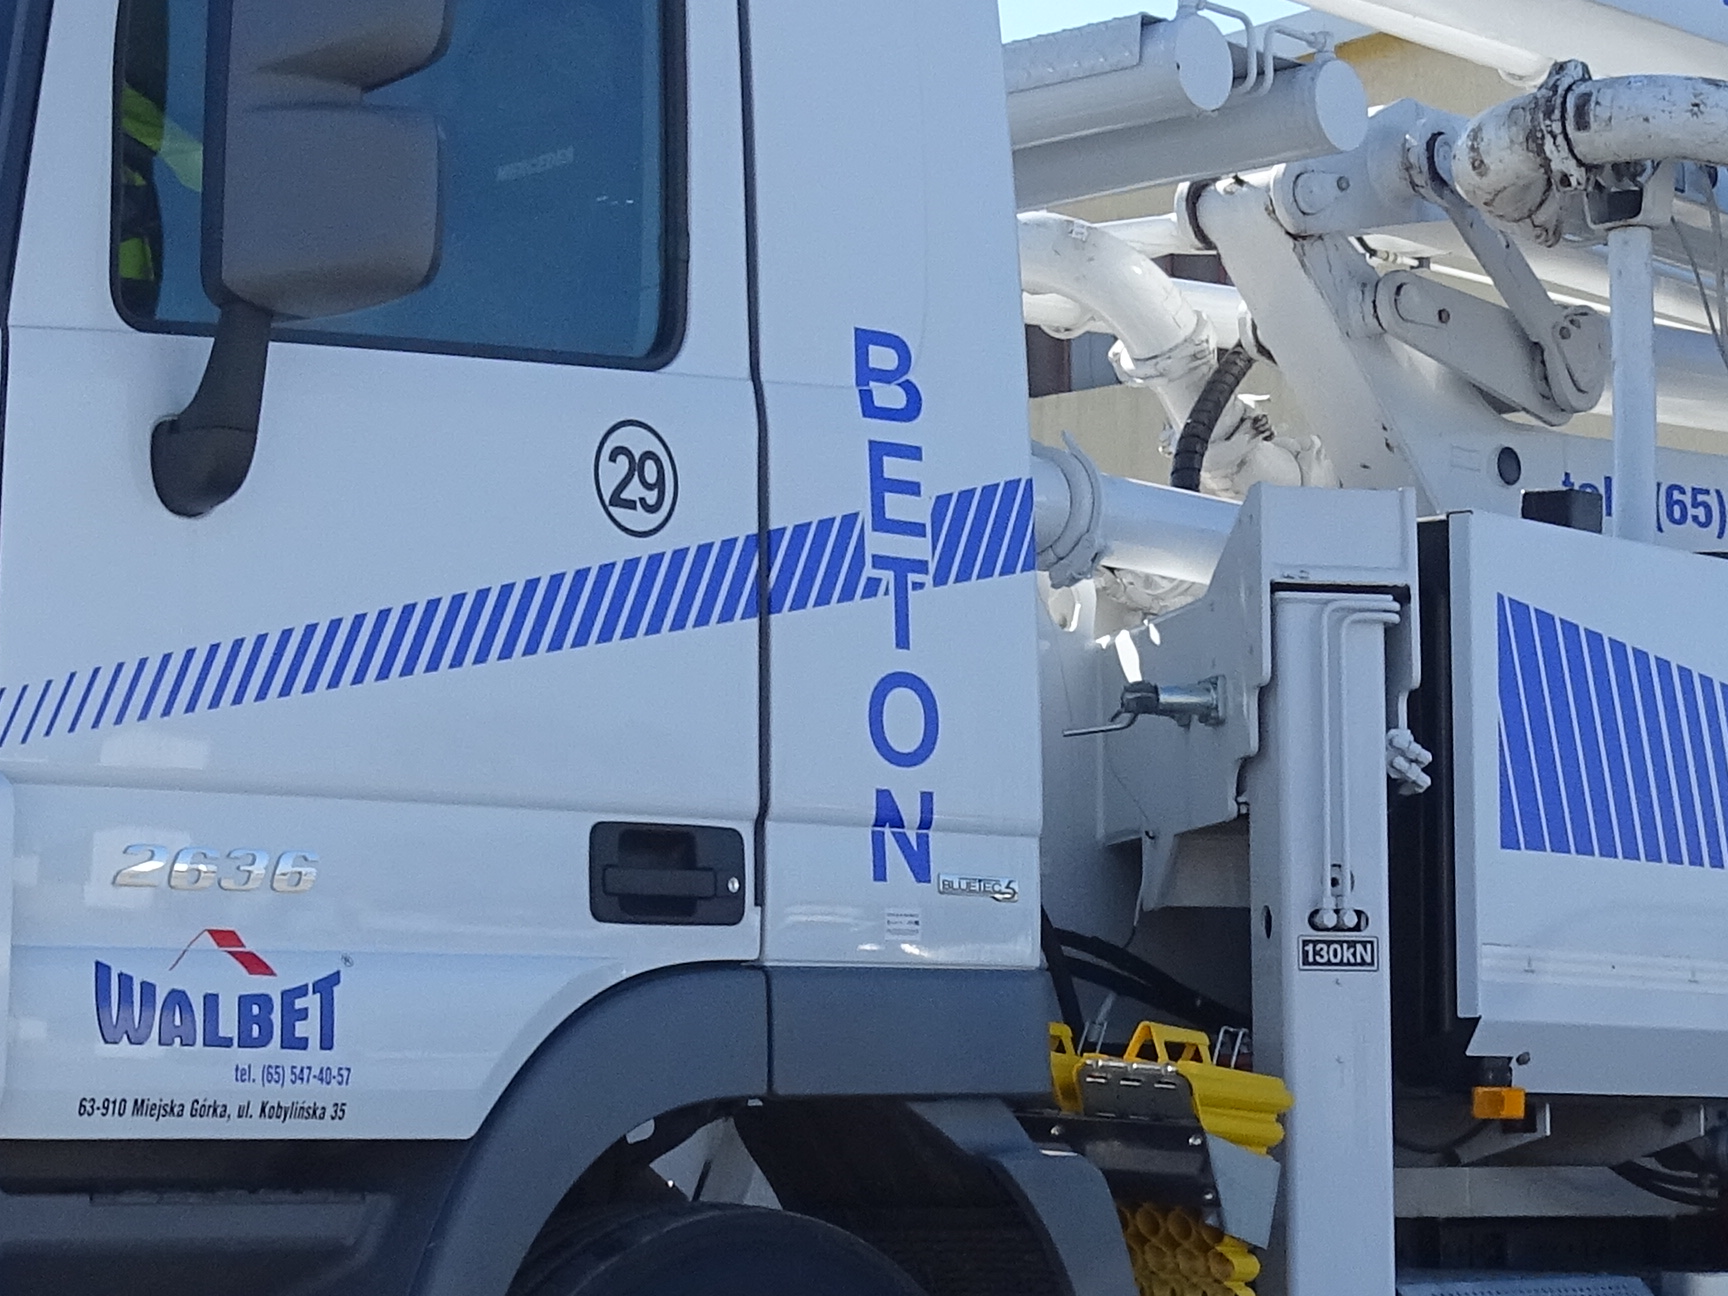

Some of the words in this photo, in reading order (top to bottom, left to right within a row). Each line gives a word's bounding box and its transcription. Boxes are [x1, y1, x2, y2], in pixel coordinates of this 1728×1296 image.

[608, 445, 666, 515] 29
[1655, 481, 1727, 540] (65)
[854, 327, 939, 884] BETON
[111, 843, 320, 894] 2636
[1303, 942, 1372, 964] 130kN
[94, 959, 341, 1051] WALBET
[234, 1063, 256, 1084] tel.
[261, 1064, 286, 1089] (65)
[289, 1065, 352, 1086] 547-40-57
[77, 1097, 128, 1118] 63-910
[131, 1097, 185, 1122] Miejska
[189, 1097, 231, 1122] Górka,
[236, 1100, 253, 1119] ul.
[258, 1100, 327, 1124] Kobylińska
[329, 1102, 347, 1121] 35
